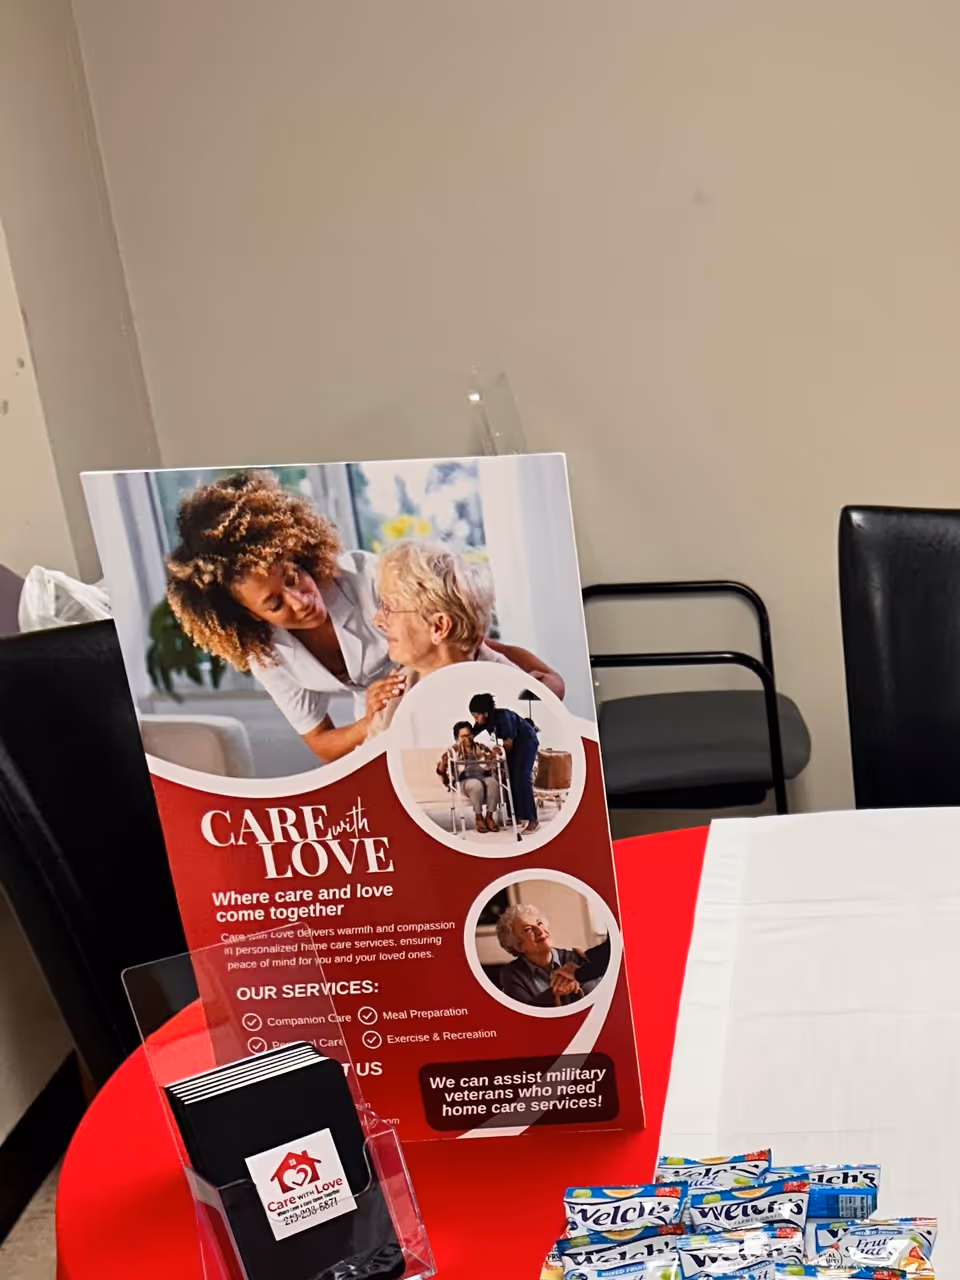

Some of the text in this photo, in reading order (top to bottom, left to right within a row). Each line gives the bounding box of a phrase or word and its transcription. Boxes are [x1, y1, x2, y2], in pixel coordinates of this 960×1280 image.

[201, 796, 370, 847] CARE with
[259, 837, 394, 879] LOVE
[212, 884, 393, 906] Where care and love
[216, 903, 344, 922] come together
[220, 921, 455, 943] Care Love delivers warmth and compassion
[235, 936, 442, 957] personalized home care ensuring
[227, 950, 434, 972] peace of mind for you and your loved ones.
[236, 980, 379, 1001] OUR SERVICES:
[267, 1013, 351, 1028] Companion Care
[382, 1007, 468, 1021] Meal Preparation
[320, 1038, 344, 1048] Care
[387, 1029, 497, 1044] Exercise & Recreation
[356, 1061, 383, 1077] US
[430, 1067, 606, 1089] We can assist military
[445, 1081, 596, 1102] veterans who need
[442, 1095, 602, 1116] home care services!
[267, 1196, 297, 1213] Care
[297, 1190, 315, 1201] WITH
[315, 1178, 343, 1194] Love
